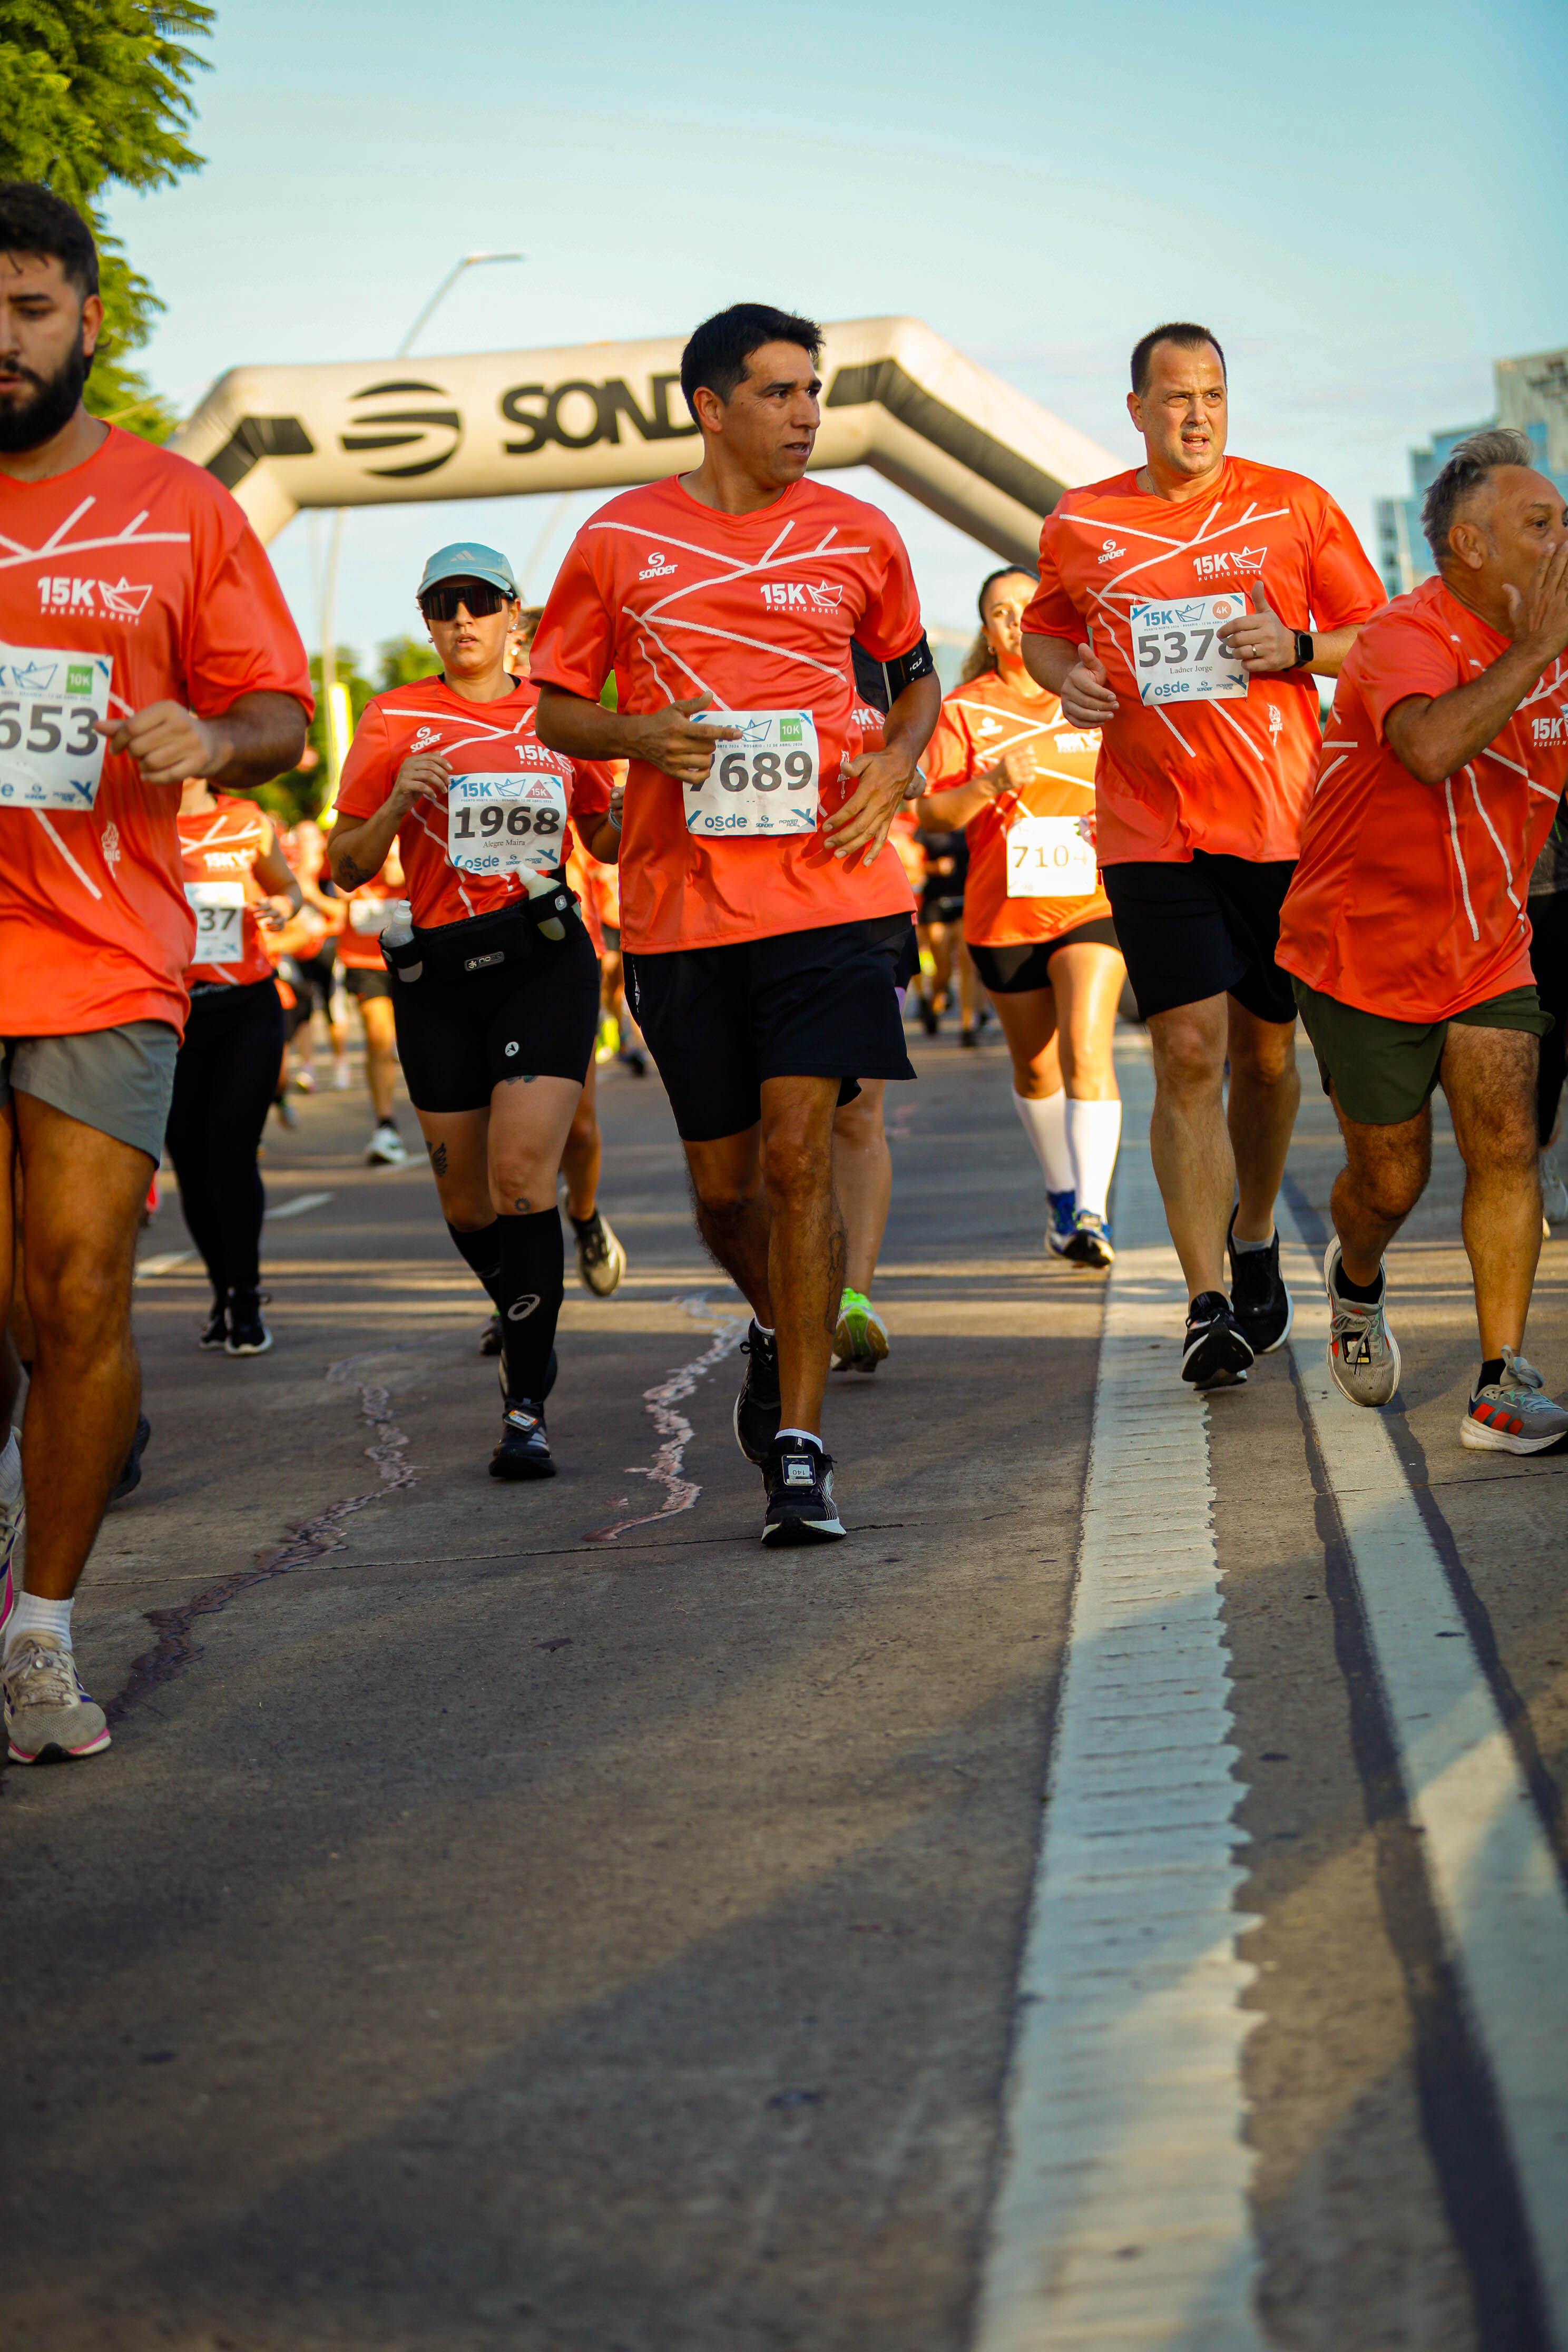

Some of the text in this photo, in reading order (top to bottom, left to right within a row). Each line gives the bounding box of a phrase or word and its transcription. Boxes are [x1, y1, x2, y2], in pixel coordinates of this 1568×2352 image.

[1193, 552, 1230, 575] 15K
[1198, 572, 1230, 582] PUERTO
[37, 576, 95, 606] 15K
[760, 583, 806, 604] 15K
[41, 606, 94, 616] PUERTO
[811, 606, 838, 615] NORTE
[1216, 606, 1228, 614] 4K
[1143, 610, 1174, 626] 15K
[1170, 664, 1213, 674] Ladner Jorge
[70, 673, 90, 687] 10K
[1154, 681, 1190, 697] osde
[782, 724, 800, 735] 10K
[1531, 718, 1564, 740] 15K
[514, 744, 554, 763] 15K
[520, 760, 555, 769] PUERTO
[690, 750, 812, 792] 689
[460, 782, 492, 797] 15K
[532, 788, 547, 797] 15K
[454, 806, 560, 839] 1968
[705, 814, 747, 831] osde
[465, 855, 499, 870] osde
